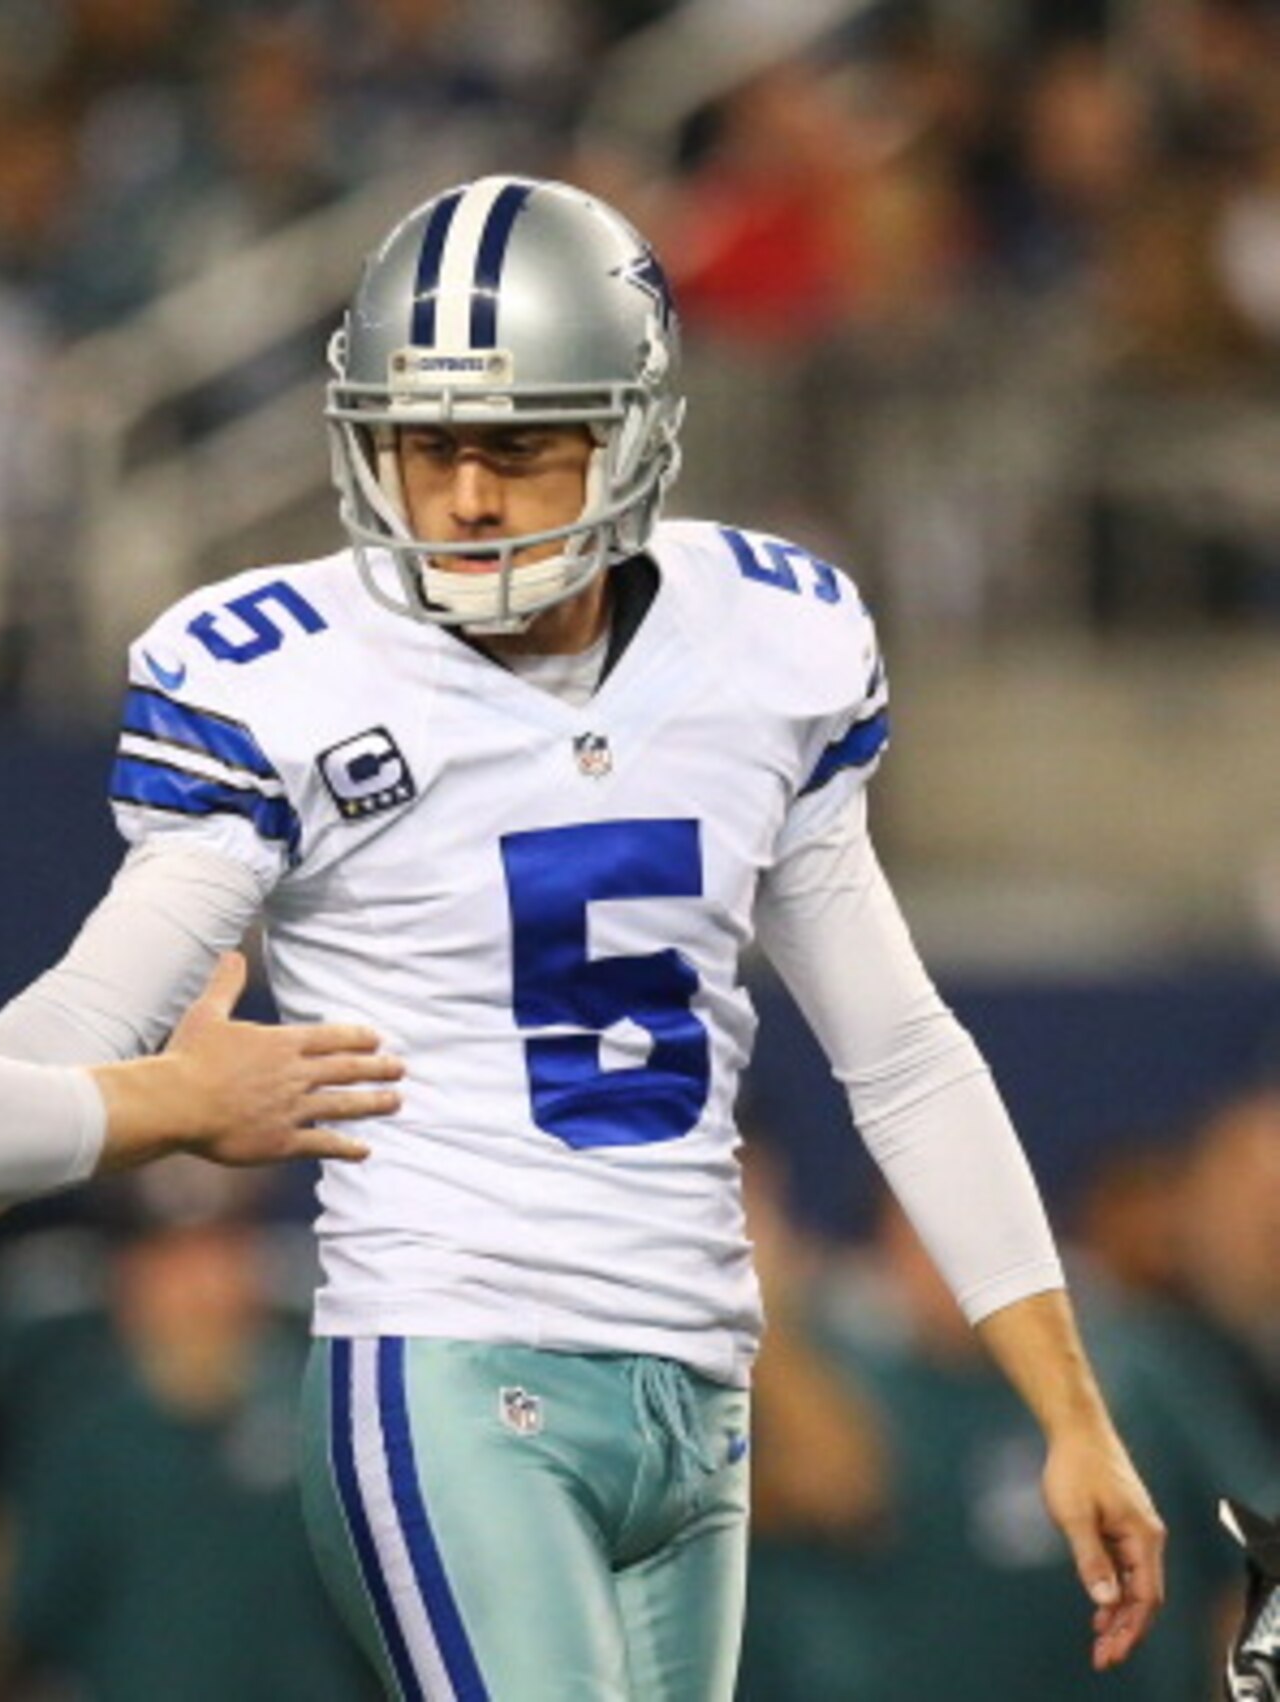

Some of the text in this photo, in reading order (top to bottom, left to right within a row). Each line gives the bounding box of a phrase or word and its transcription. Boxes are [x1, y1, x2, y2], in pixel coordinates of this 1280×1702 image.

[186, 580, 328, 664] 5
[323, 734, 402, 799] C
[500, 818, 711, 1150] 5
